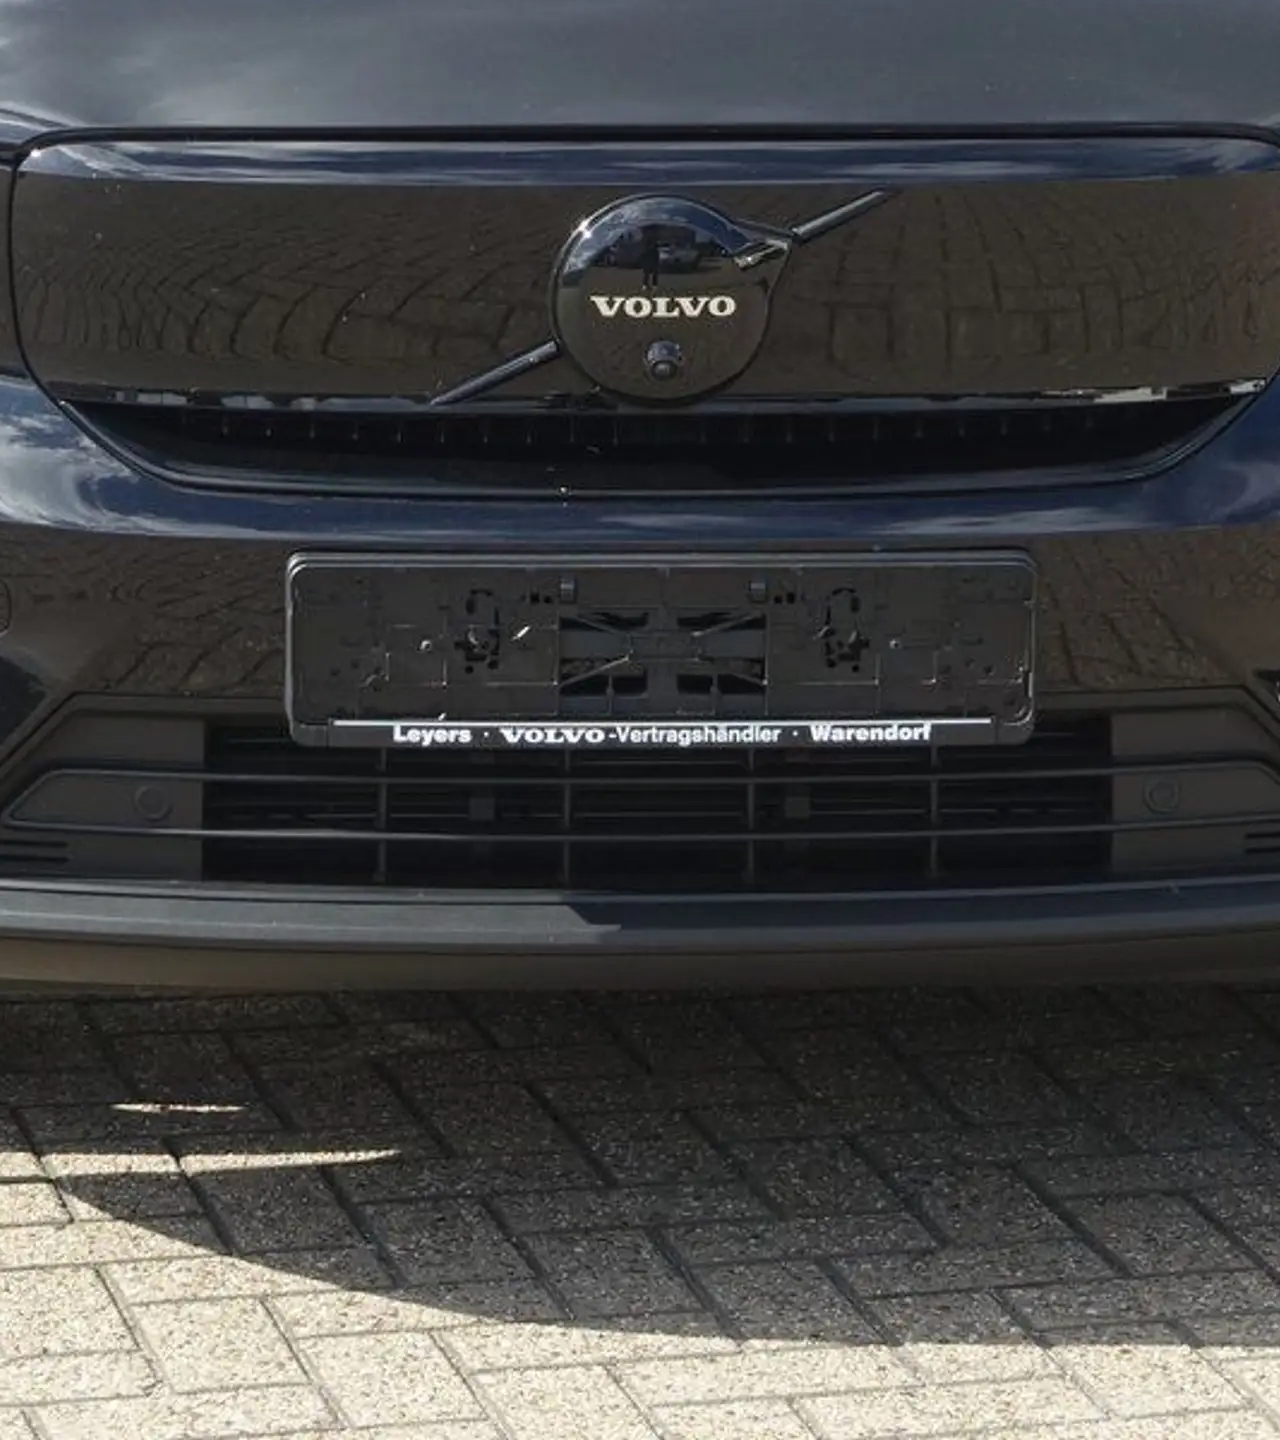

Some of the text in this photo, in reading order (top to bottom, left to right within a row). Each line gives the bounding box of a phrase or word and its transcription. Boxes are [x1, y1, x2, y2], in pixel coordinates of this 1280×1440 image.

[590, 295, 736, 318] VOLVO
[393, 724, 471, 746] Leyers
[810, 723, 932, 742] Warendorf
